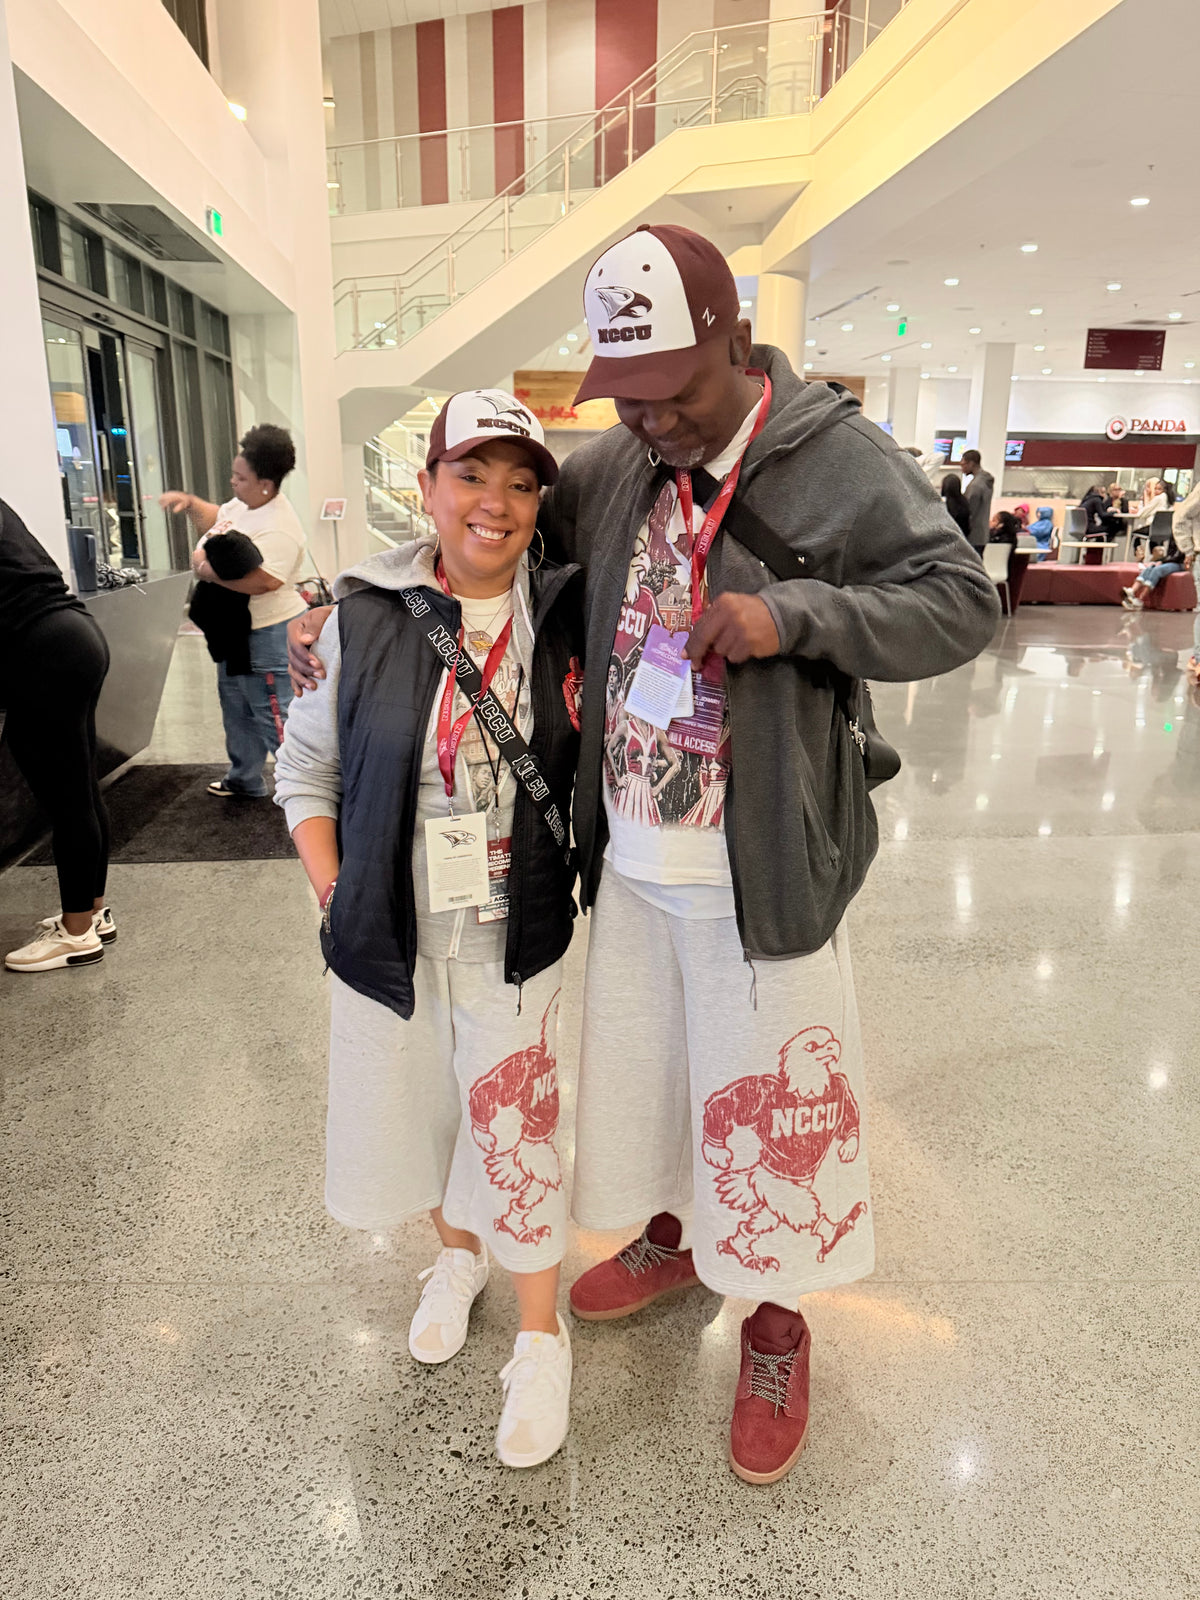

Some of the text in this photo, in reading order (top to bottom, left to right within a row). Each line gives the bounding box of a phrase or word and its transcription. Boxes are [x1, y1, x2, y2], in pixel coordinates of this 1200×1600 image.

[598, 325, 652, 344] NCCU
[1130, 419, 1187, 433] PANDA
[428, 624, 474, 678] NCCU
[669, 731, 683, 747] ALL
[684, 735, 718, 755] ACCESS
[770, 1101, 840, 1139] NCCU
